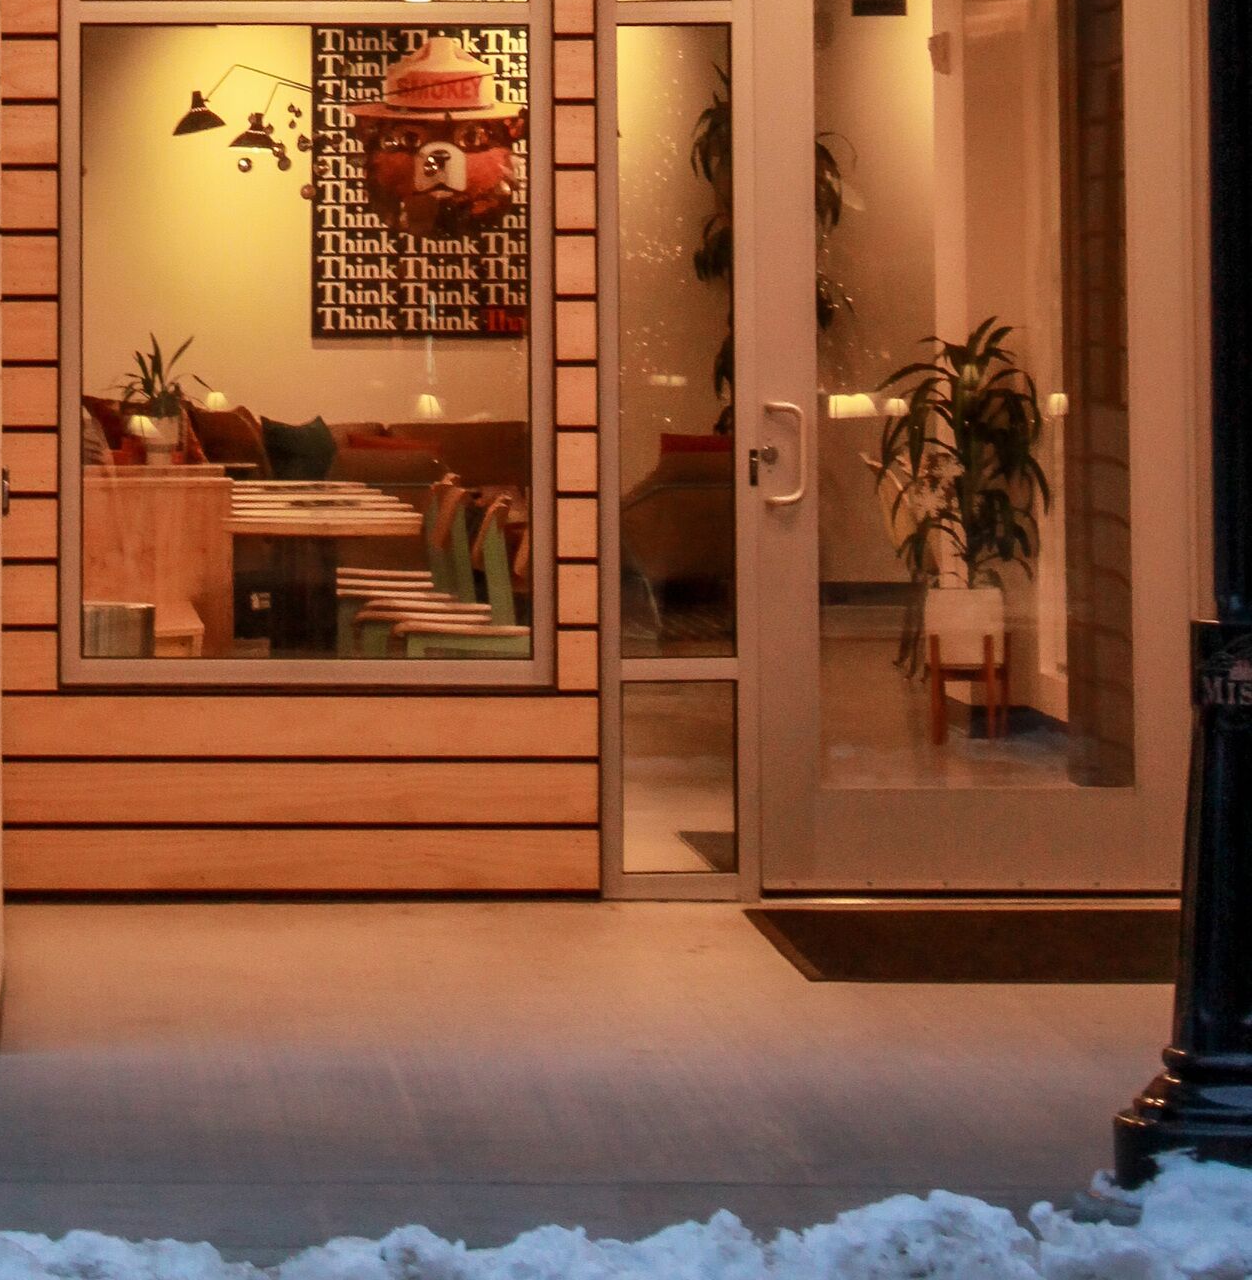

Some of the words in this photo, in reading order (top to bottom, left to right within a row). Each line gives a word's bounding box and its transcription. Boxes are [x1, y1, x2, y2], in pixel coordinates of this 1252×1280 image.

[317, 28, 398, 52] Think
[317, 206, 388, 229] Thin
[317, 231, 397, 254] Think
[317, 256, 397, 279] Think
[399, 257, 480, 279] Think
[317, 282, 397, 305] Think
[399, 283, 480, 305] Think
[317, 307, 397, 330] Think
[399, 308, 480, 330] Think
